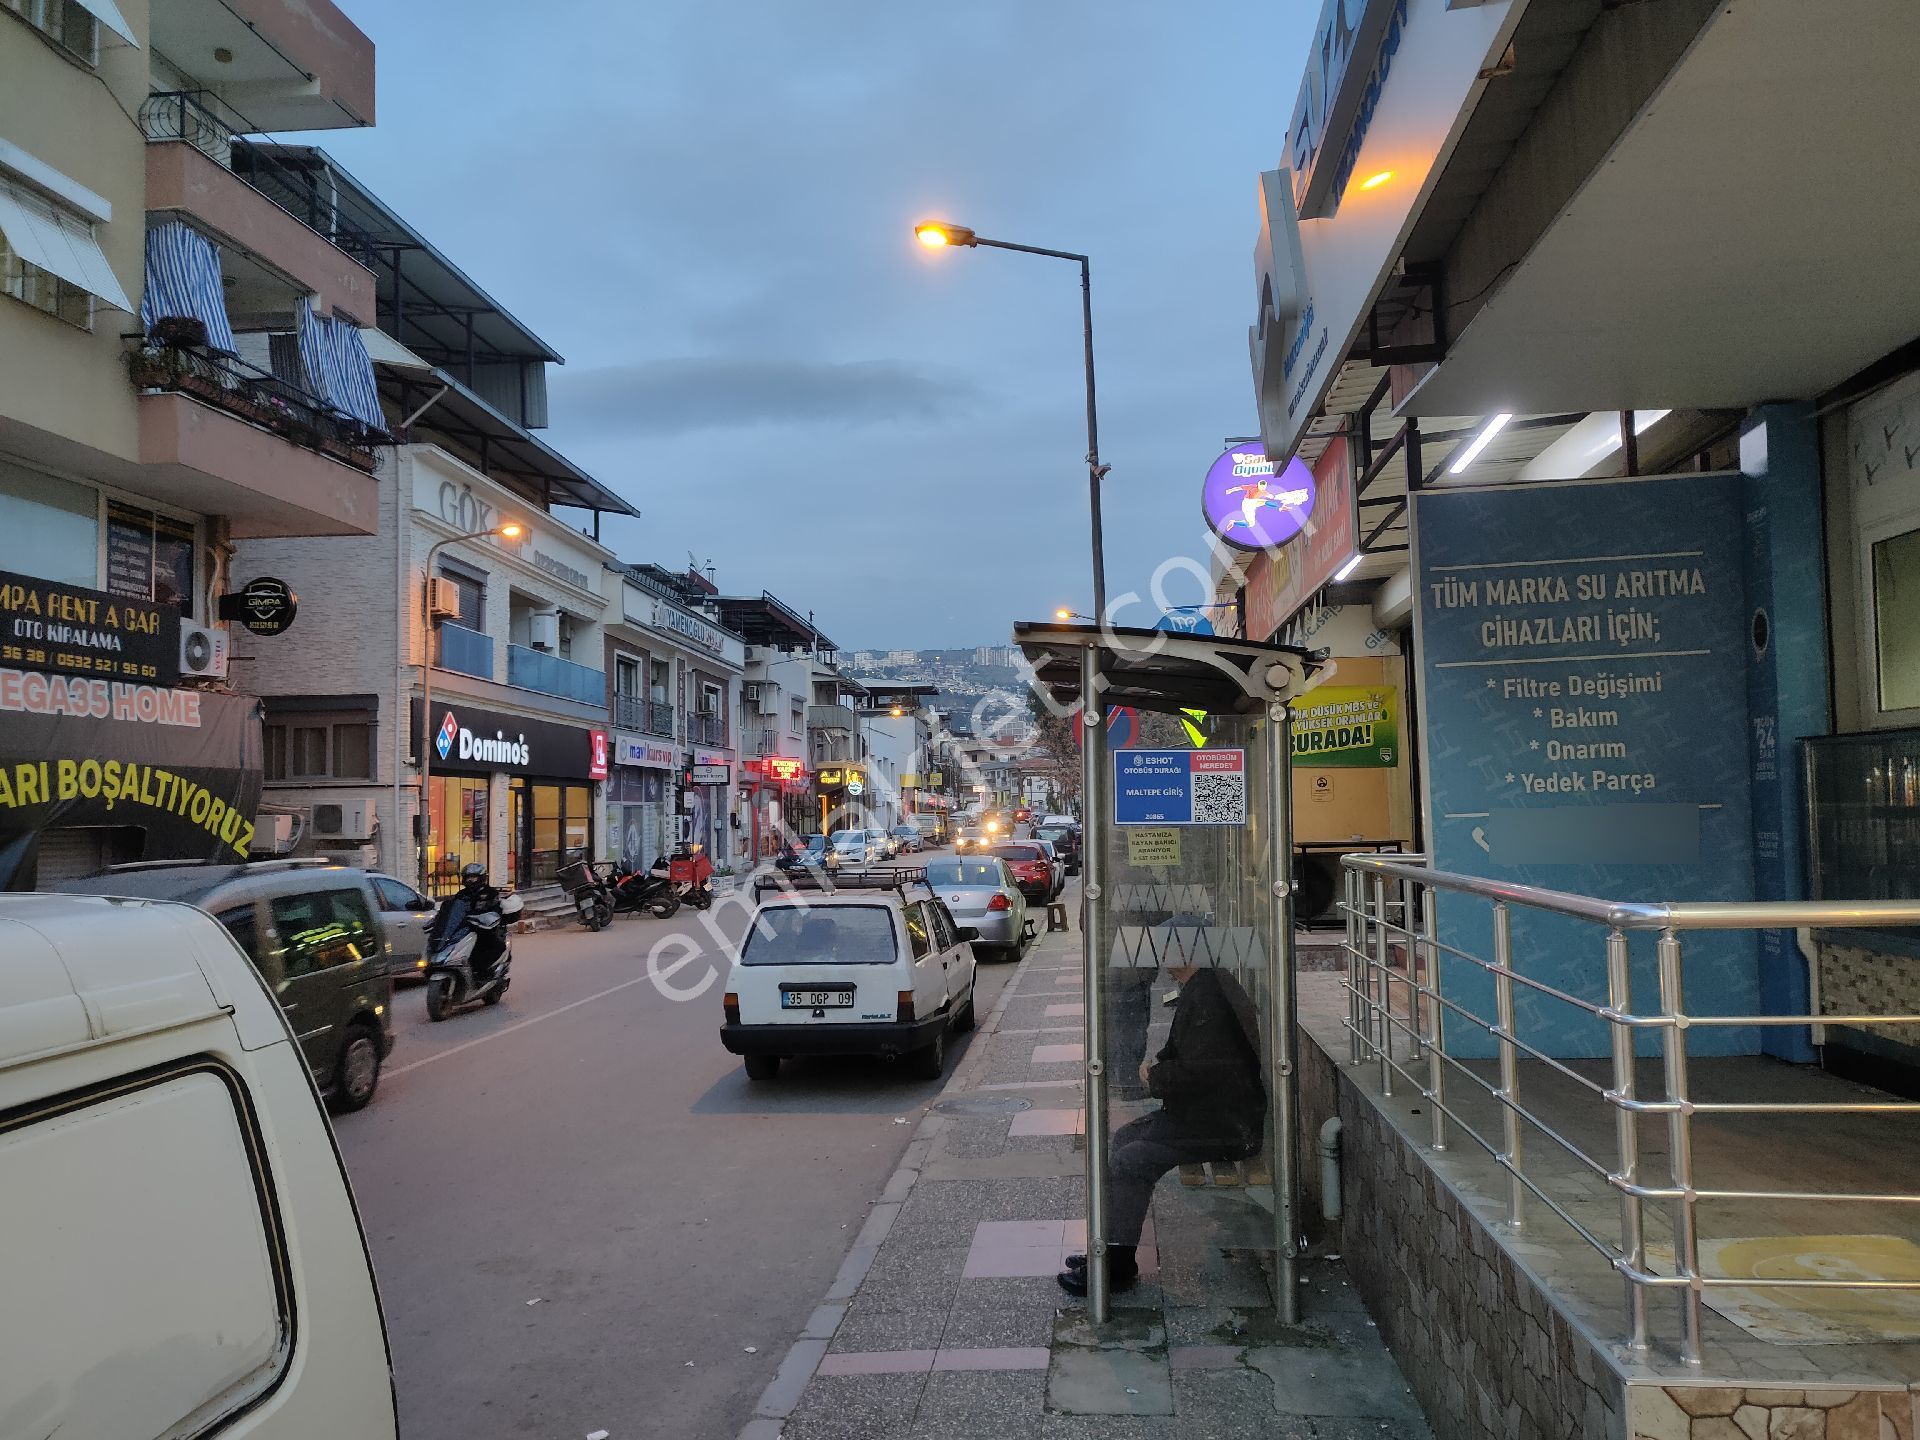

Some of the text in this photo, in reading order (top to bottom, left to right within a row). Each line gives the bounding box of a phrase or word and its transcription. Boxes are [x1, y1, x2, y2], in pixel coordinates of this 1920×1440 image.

[1235, 464, 1274, 475] Oyunl
[1431, 568, 1706, 609] TÜM MARKA SU ARITMA
[48, 592, 99, 625] RENT
[105, 604, 120, 629] A
[125, 607, 160, 636] CAR
[15, 618, 121, 651] OTO KİRALAMA
[1481, 606, 1661, 648] CİHAZLARI İÇİN;
[57, 653, 92, 669] 0532
[95, 658, 118, 673] 521
[122, 662, 138, 676] 95
[141, 664, 157, 678] 60
[1503, 671, 1662, 700] Filtre Değişimi
[112, 682, 201, 727] HOME
[1296, 711, 1381, 732] YÜKSEK ORANLAR
[1550, 706, 1618, 729] Bakım
[459, 728, 530, 767] Domino's
[1546, 739, 1626, 761] Onarım
[1123, 766, 1182, 775] OTOBÜS DURAĞI
[1145, 757, 1174, 765] ESHOT
[1126, 786, 1184, 798] MALTEPE GİRİŞ
[1521, 769, 1656, 795] Yedek Parça
[57, 758, 256, 861] BOŞALTIYORUZ
[790, 992, 851, 1005] 35 DGP 09
